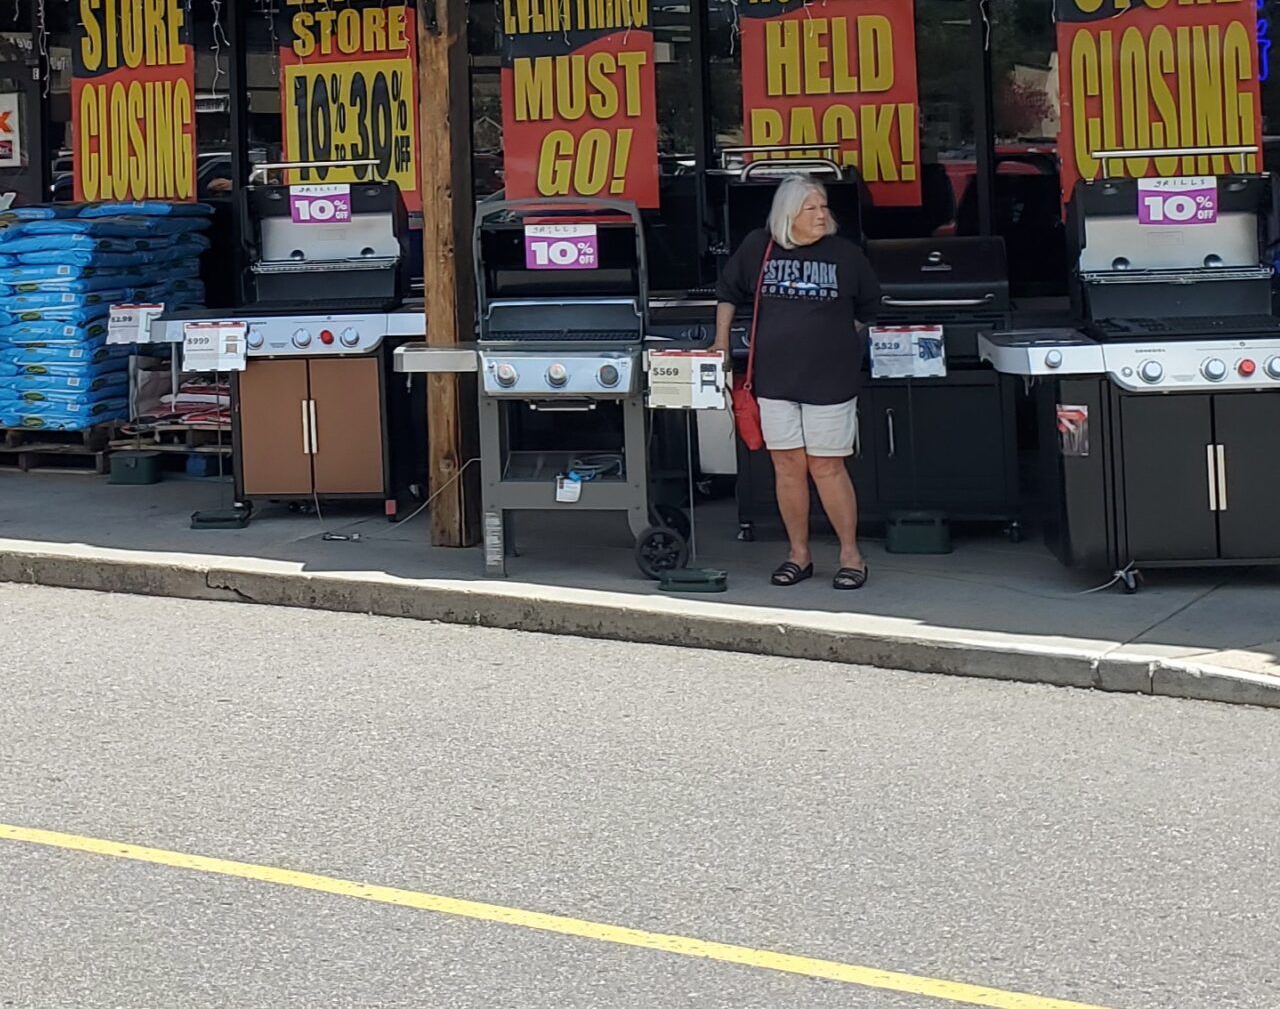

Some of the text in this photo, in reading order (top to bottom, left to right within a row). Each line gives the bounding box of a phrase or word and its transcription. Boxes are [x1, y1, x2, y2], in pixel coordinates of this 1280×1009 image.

[292, 6, 407, 57] STORE
[765, 14, 895, 96] HELD
[513, 51, 647, 122] MUST
[1071, 20, 1257, 179] CLOSING
[80, 77, 194, 202] CLOSING
[537, 128, 634, 197] GO!
[751, 102, 917, 182] BACK!
[1197, 209, 1214, 220] OFF
[578, 255, 595, 265] OFF
[803, 261, 838, 284] PARK
[761, 285, 839, 298] COLORADO
[187, 338, 210, 346] $999
[652, 367, 680, 377] $569
